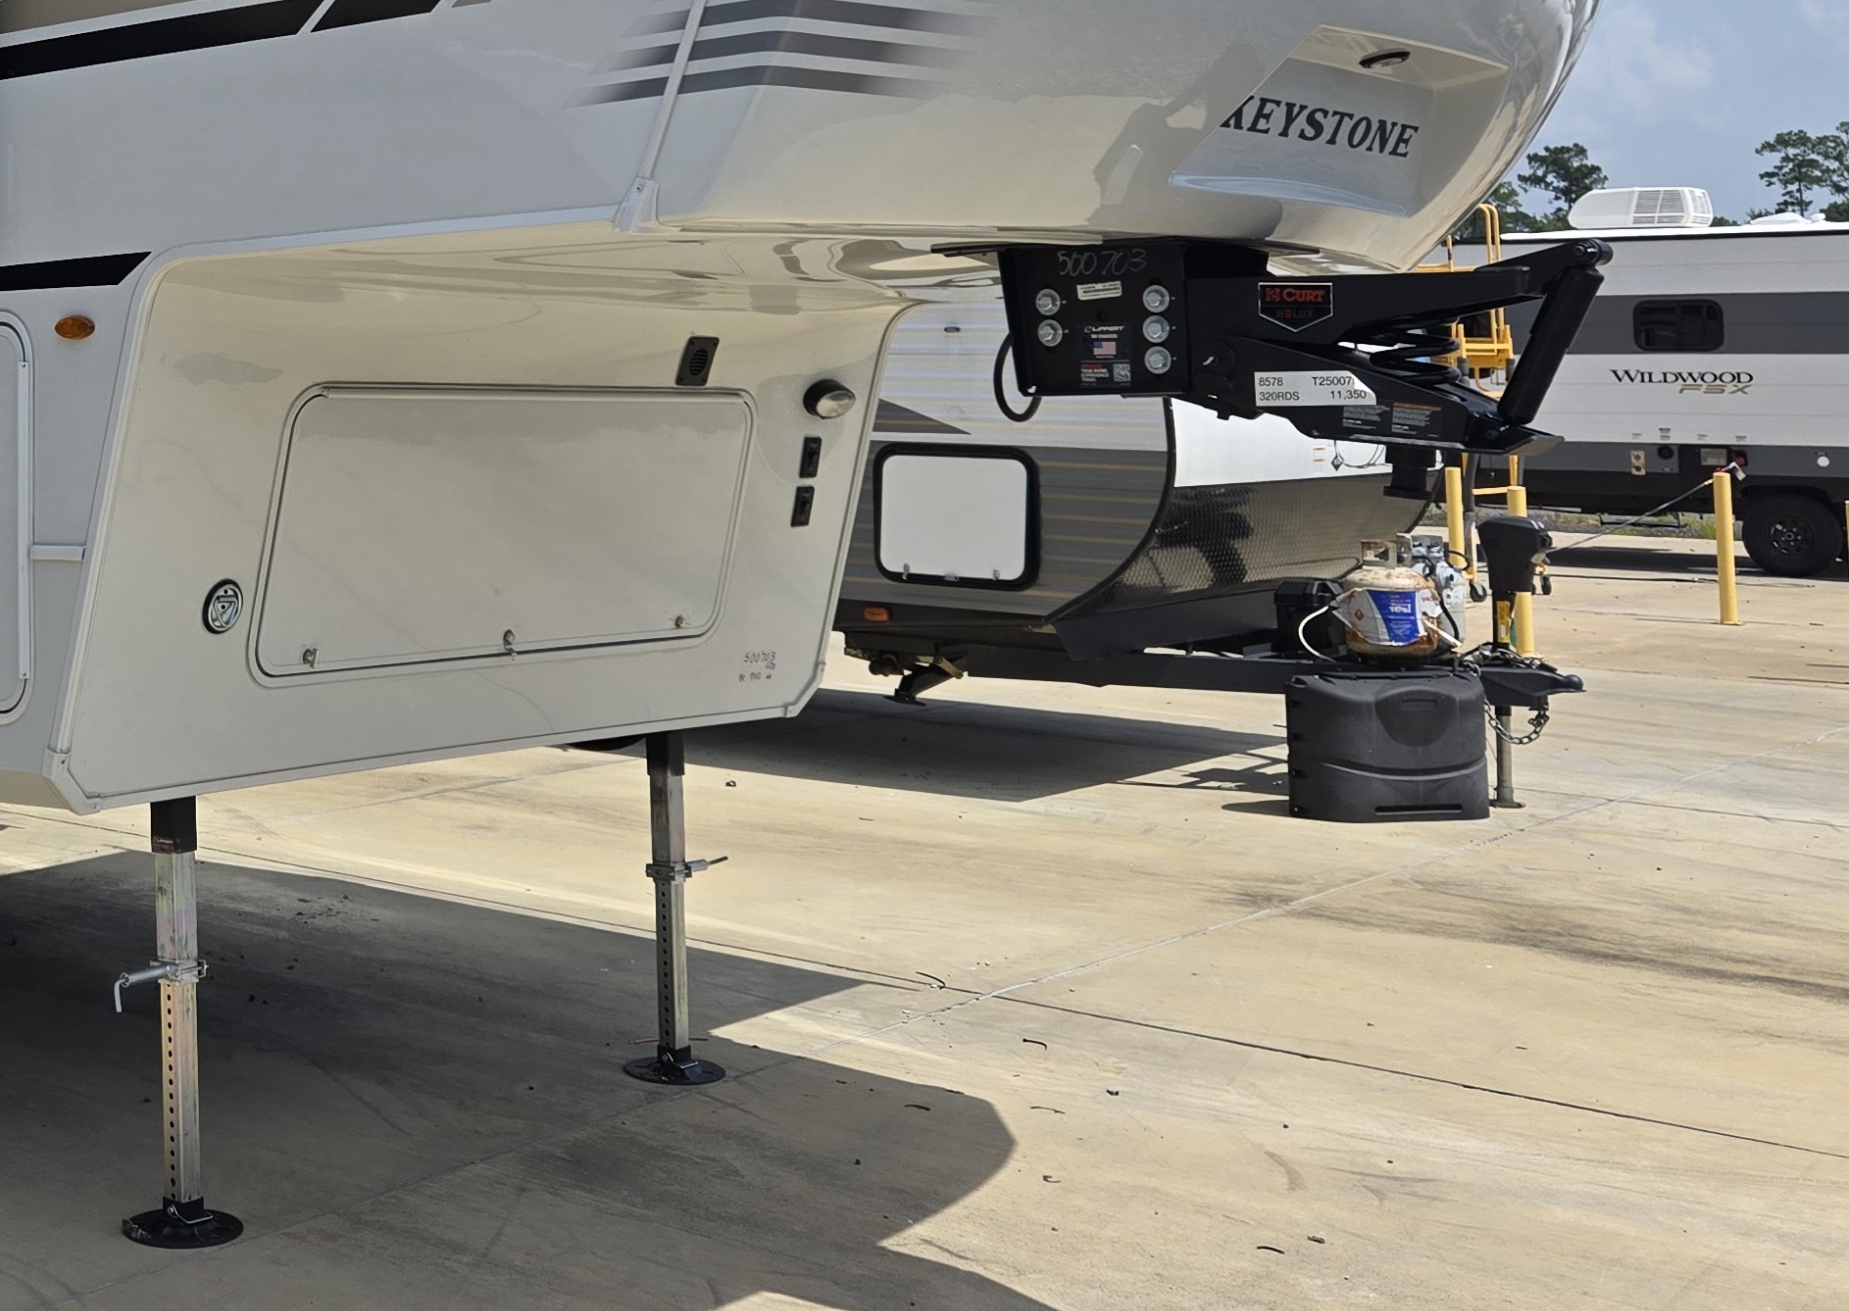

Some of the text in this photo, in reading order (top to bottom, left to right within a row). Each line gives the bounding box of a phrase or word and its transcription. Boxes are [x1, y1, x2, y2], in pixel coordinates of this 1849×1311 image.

[1282, 288, 1326, 302] CURT
[1258, 376, 1355, 387] 8578 T25007
[1610, 369, 1754, 384] WILDWOOD
[1259, 389, 1367, 401] 320RDS 11,350
